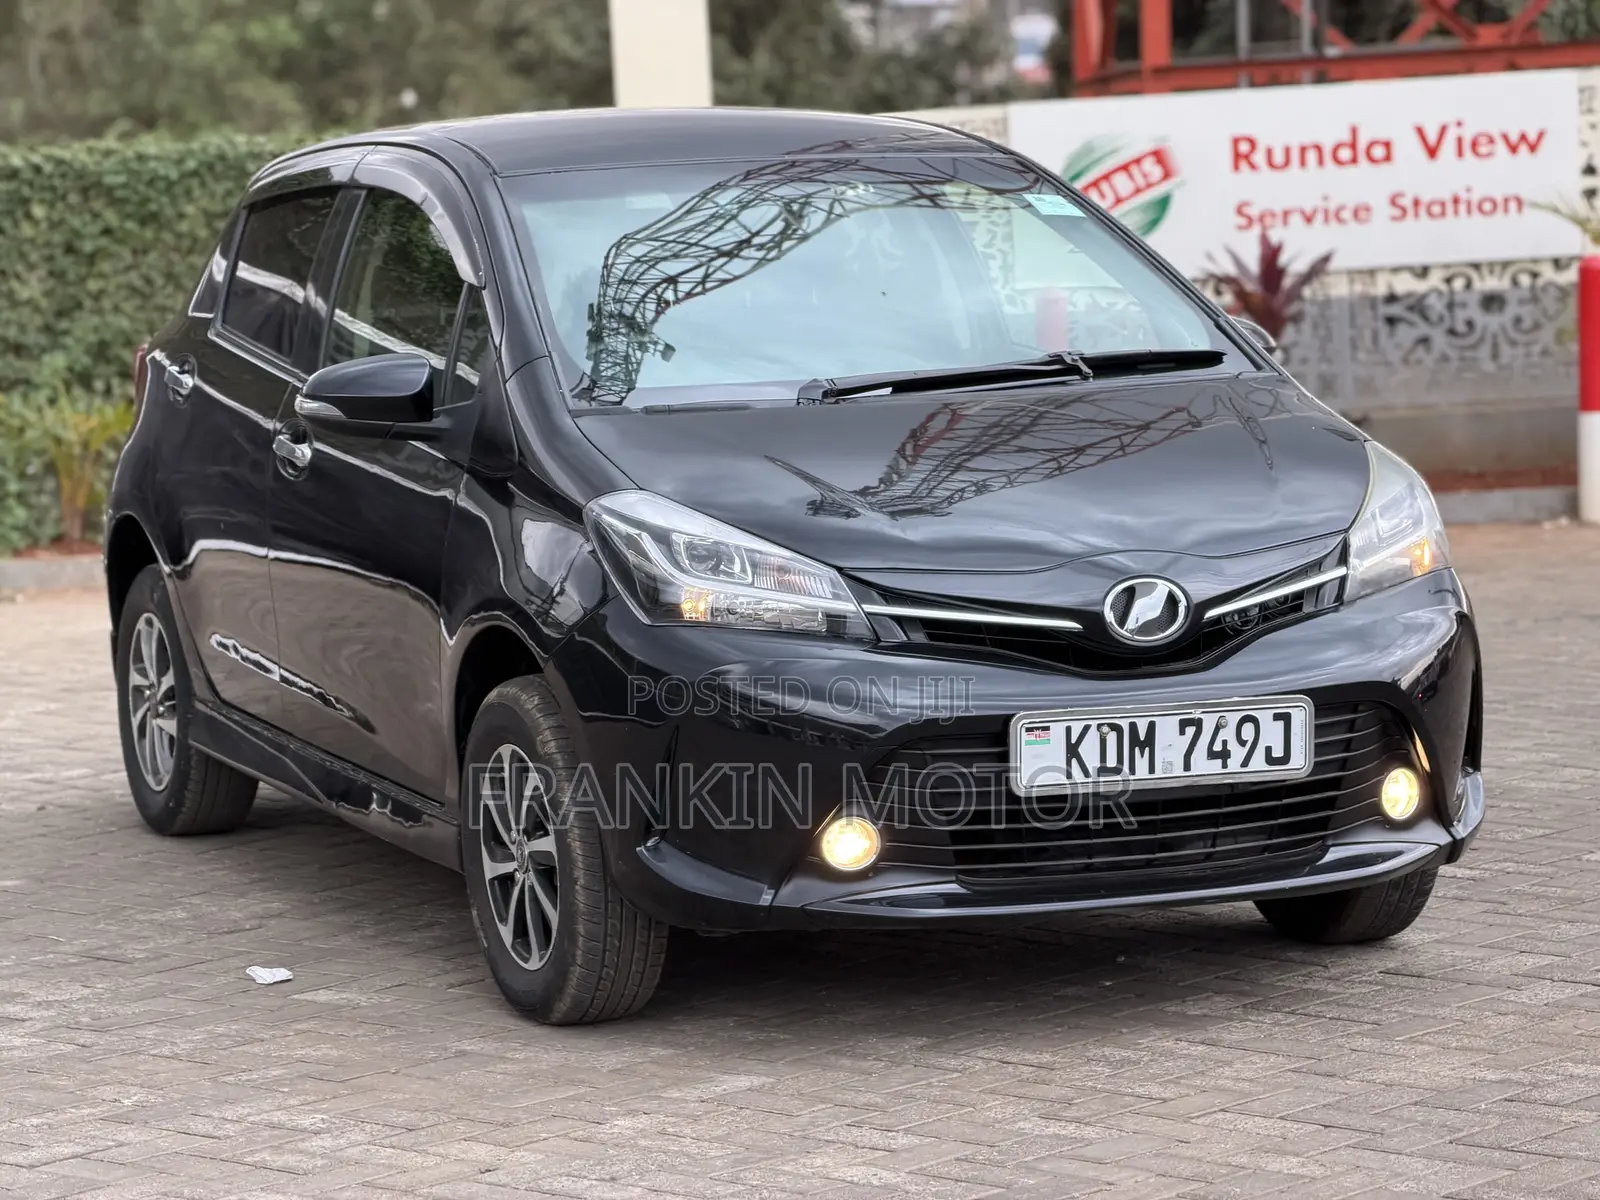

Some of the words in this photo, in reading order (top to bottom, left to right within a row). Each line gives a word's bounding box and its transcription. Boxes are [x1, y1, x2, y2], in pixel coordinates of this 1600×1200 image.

[1230, 125, 1393, 173] Runda
[1414, 119, 1546, 161] View
[1086, 153, 1166, 211] UBIS
[1234, 197, 1372, 231] Service
[1389, 187, 1523, 221] Station
[1065, 720, 1157, 779] KDM
[1178, 712, 1292, 772] 749J
